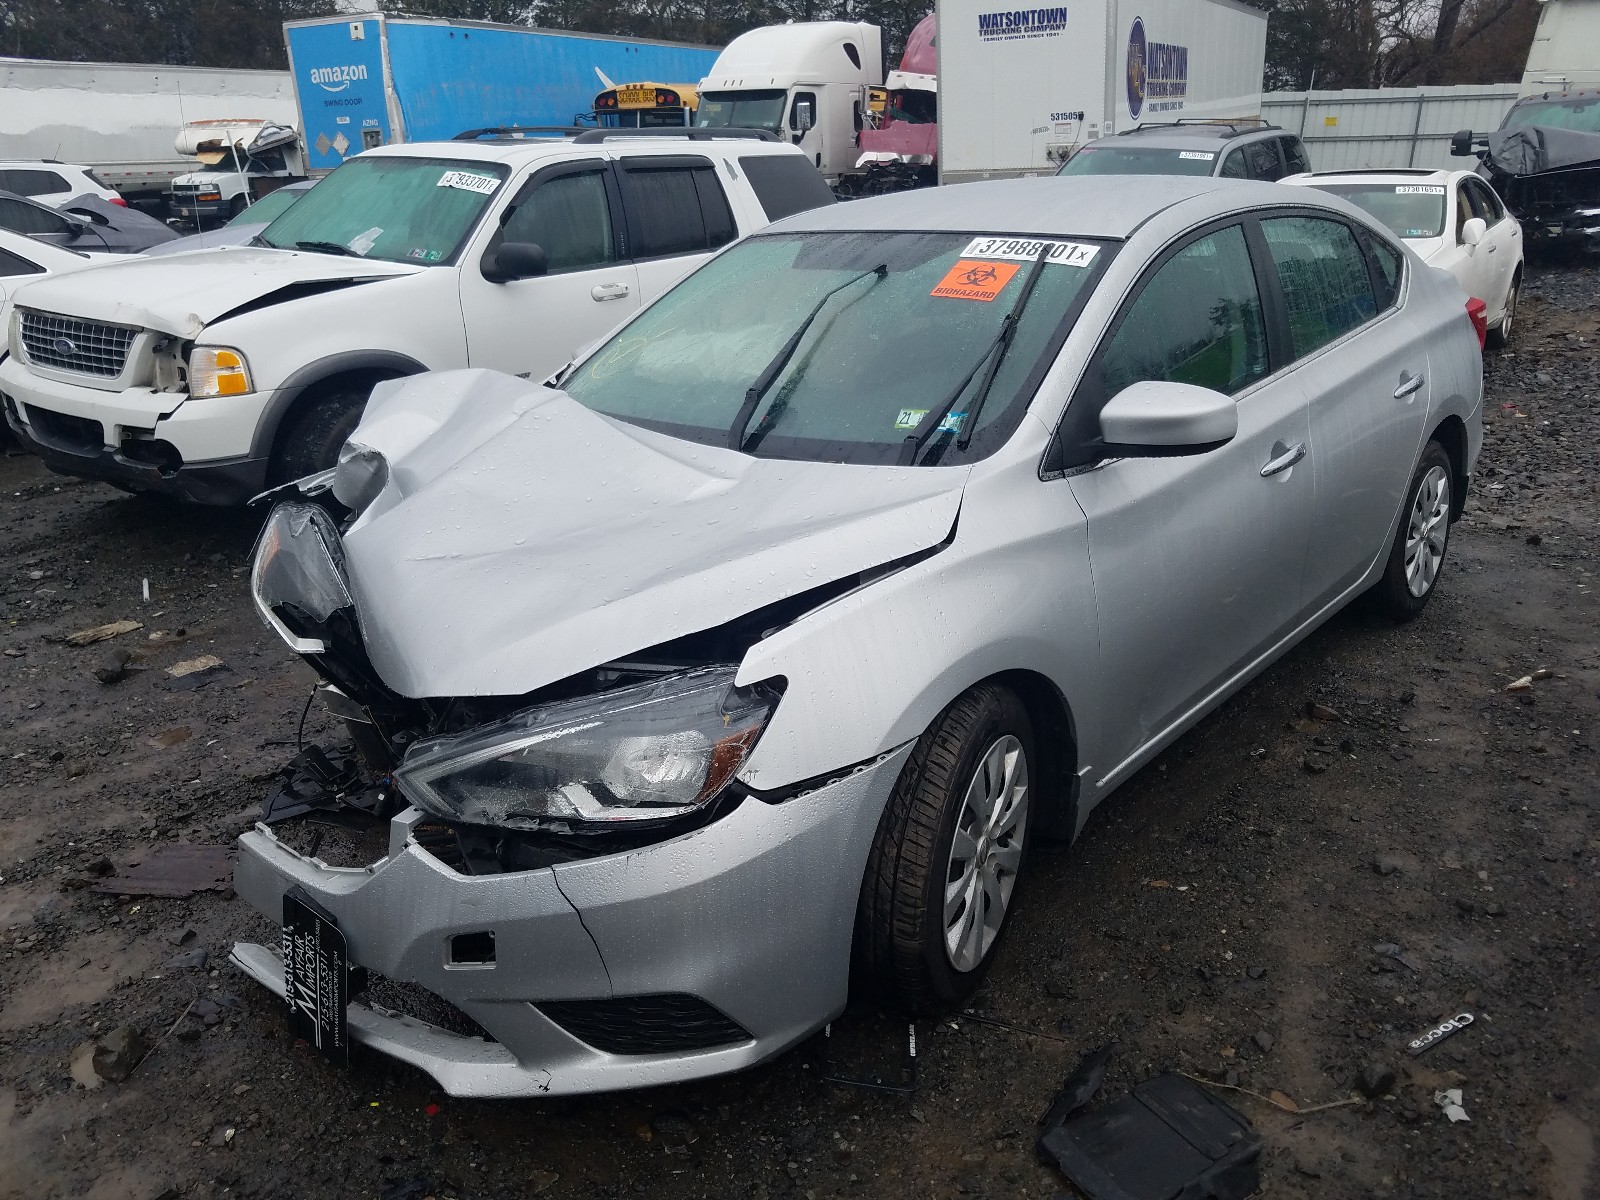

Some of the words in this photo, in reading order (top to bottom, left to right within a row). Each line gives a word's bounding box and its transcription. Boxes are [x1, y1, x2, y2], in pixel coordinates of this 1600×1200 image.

[978, 7, 1067, 29] WATSONTOWN
[979, 27, 1022, 37] TRUCKING
[1024, 23, 1066, 33] COMPANY
[1147, 42, 1188, 80] WATSONTOWN
[310, 64, 368, 84] amazon
[618, 92, 641, 103] SCHOOL
[642, 90, 655, 102] BUS
[934, 287, 997, 299] BIOHAZARD
[899, 411, 912, 425] 21
[304, 931, 316, 991] IMPORTS
[320, 949, 330, 1032] 215-613-5311
[1408, 1013, 1475, 1049] Ciocca
